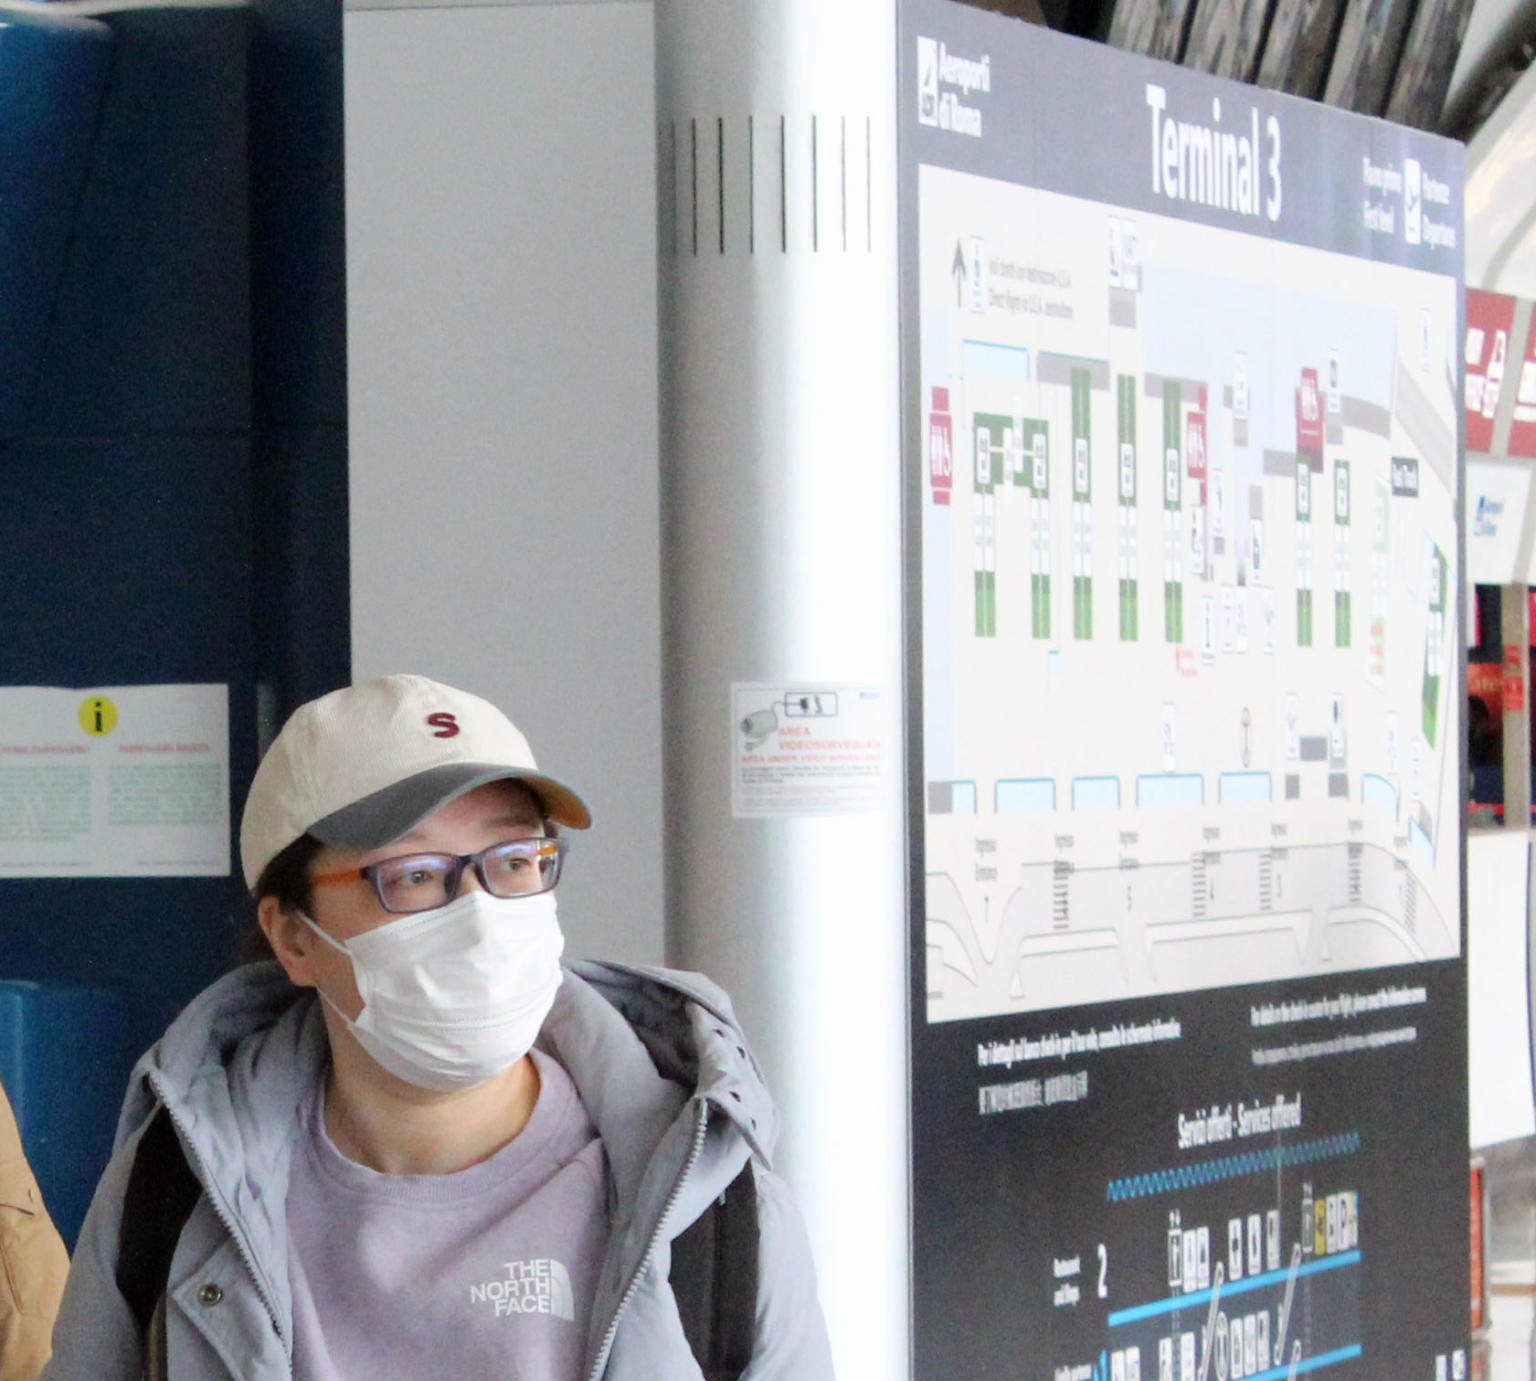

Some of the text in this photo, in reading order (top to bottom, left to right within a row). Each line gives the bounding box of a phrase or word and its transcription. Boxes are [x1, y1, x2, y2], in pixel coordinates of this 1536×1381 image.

[1145, 83, 1282, 222] Terminal 3
[426, 712, 460, 738] S
[504, 1258, 549, 1279] THE
[470, 1277, 550, 1304] NORTH
[495, 1294, 550, 1318] FACE
